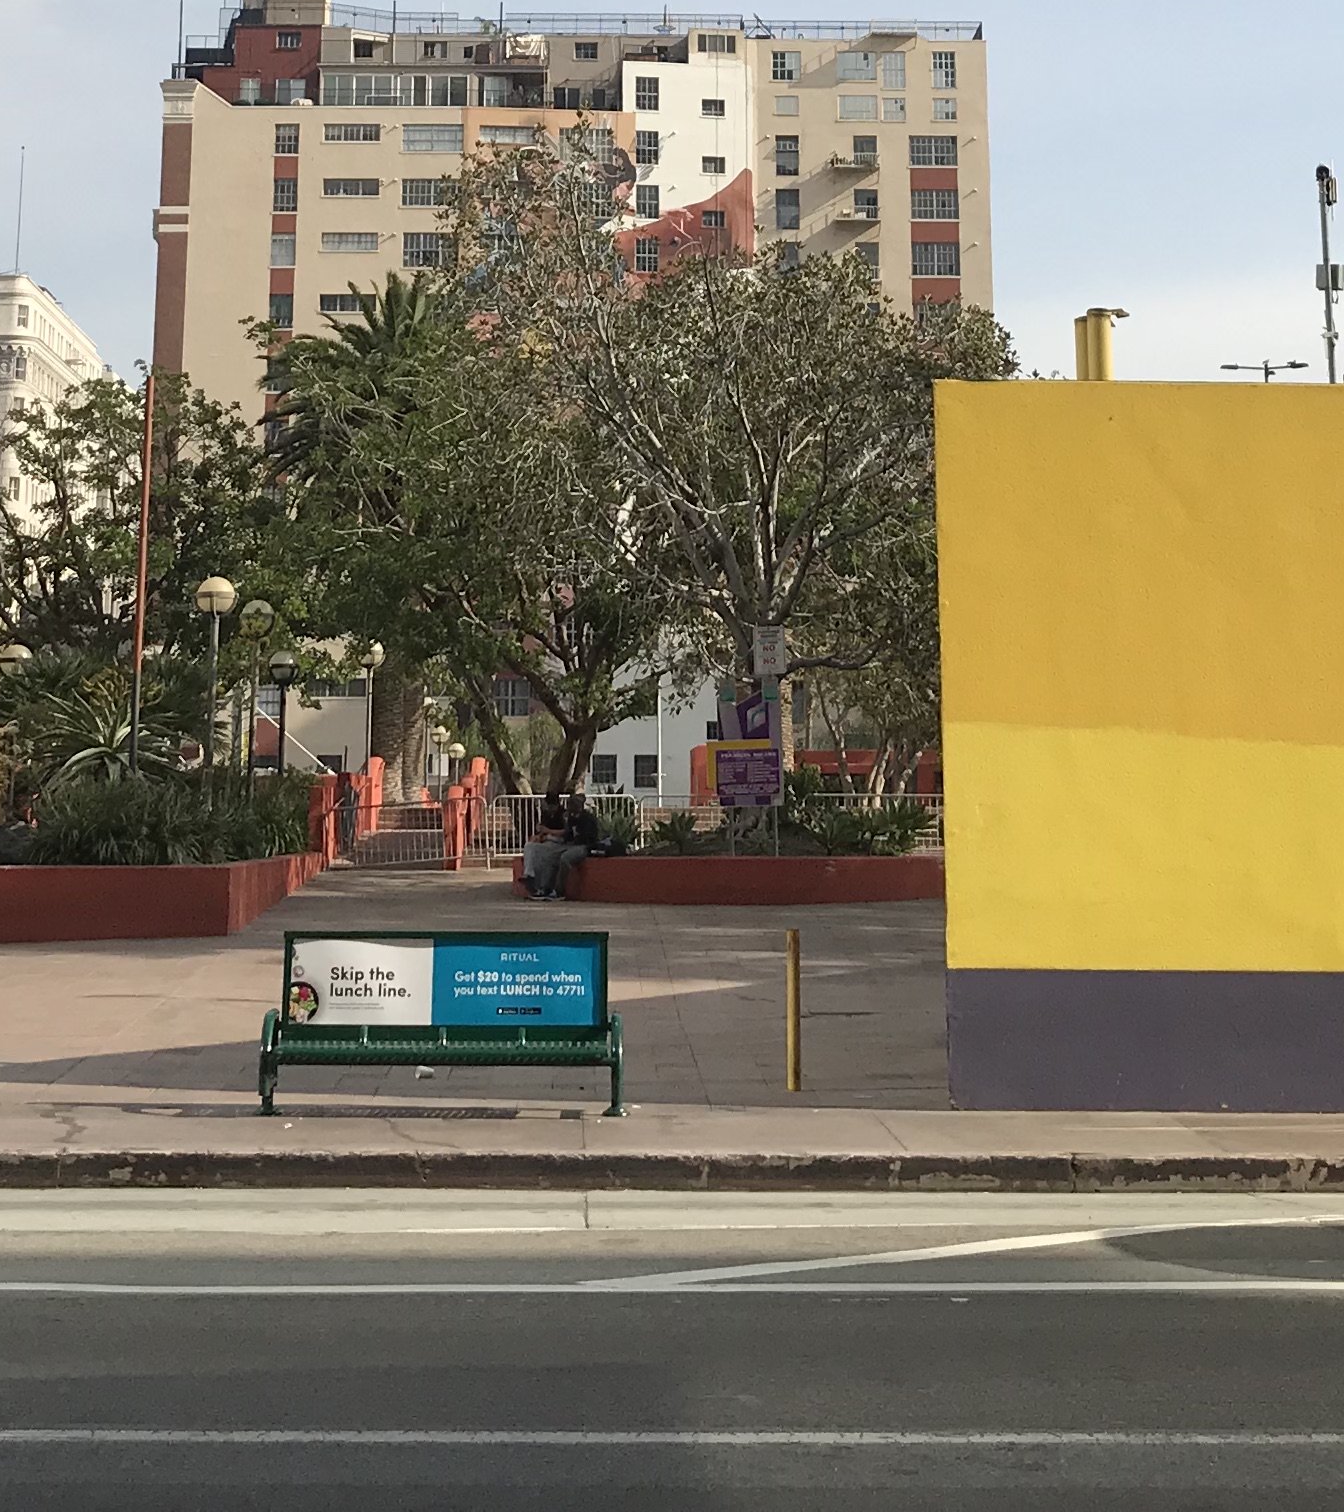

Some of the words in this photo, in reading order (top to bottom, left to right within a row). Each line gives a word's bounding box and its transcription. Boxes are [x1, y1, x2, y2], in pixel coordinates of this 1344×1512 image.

[500, 952, 540, 962] RITUAL
[330, 966, 364, 984] Skip
[369, 966, 395, 981] the
[454, 971, 475, 982] Get
[477, 970, 499, 983] $20
[501, 972, 513, 982] to
[515, 971, 549, 984] spend
[551, 971, 582, 982] when
[329, 982, 373, 997] lunch
[378, 982, 411, 997] line.
[453, 986, 474, 998] you
[476, 985, 497, 995] text
[500, 984, 540, 996] LUNCH
[542, 985, 554, 996] to
[556, 985, 585, 996] 47711
